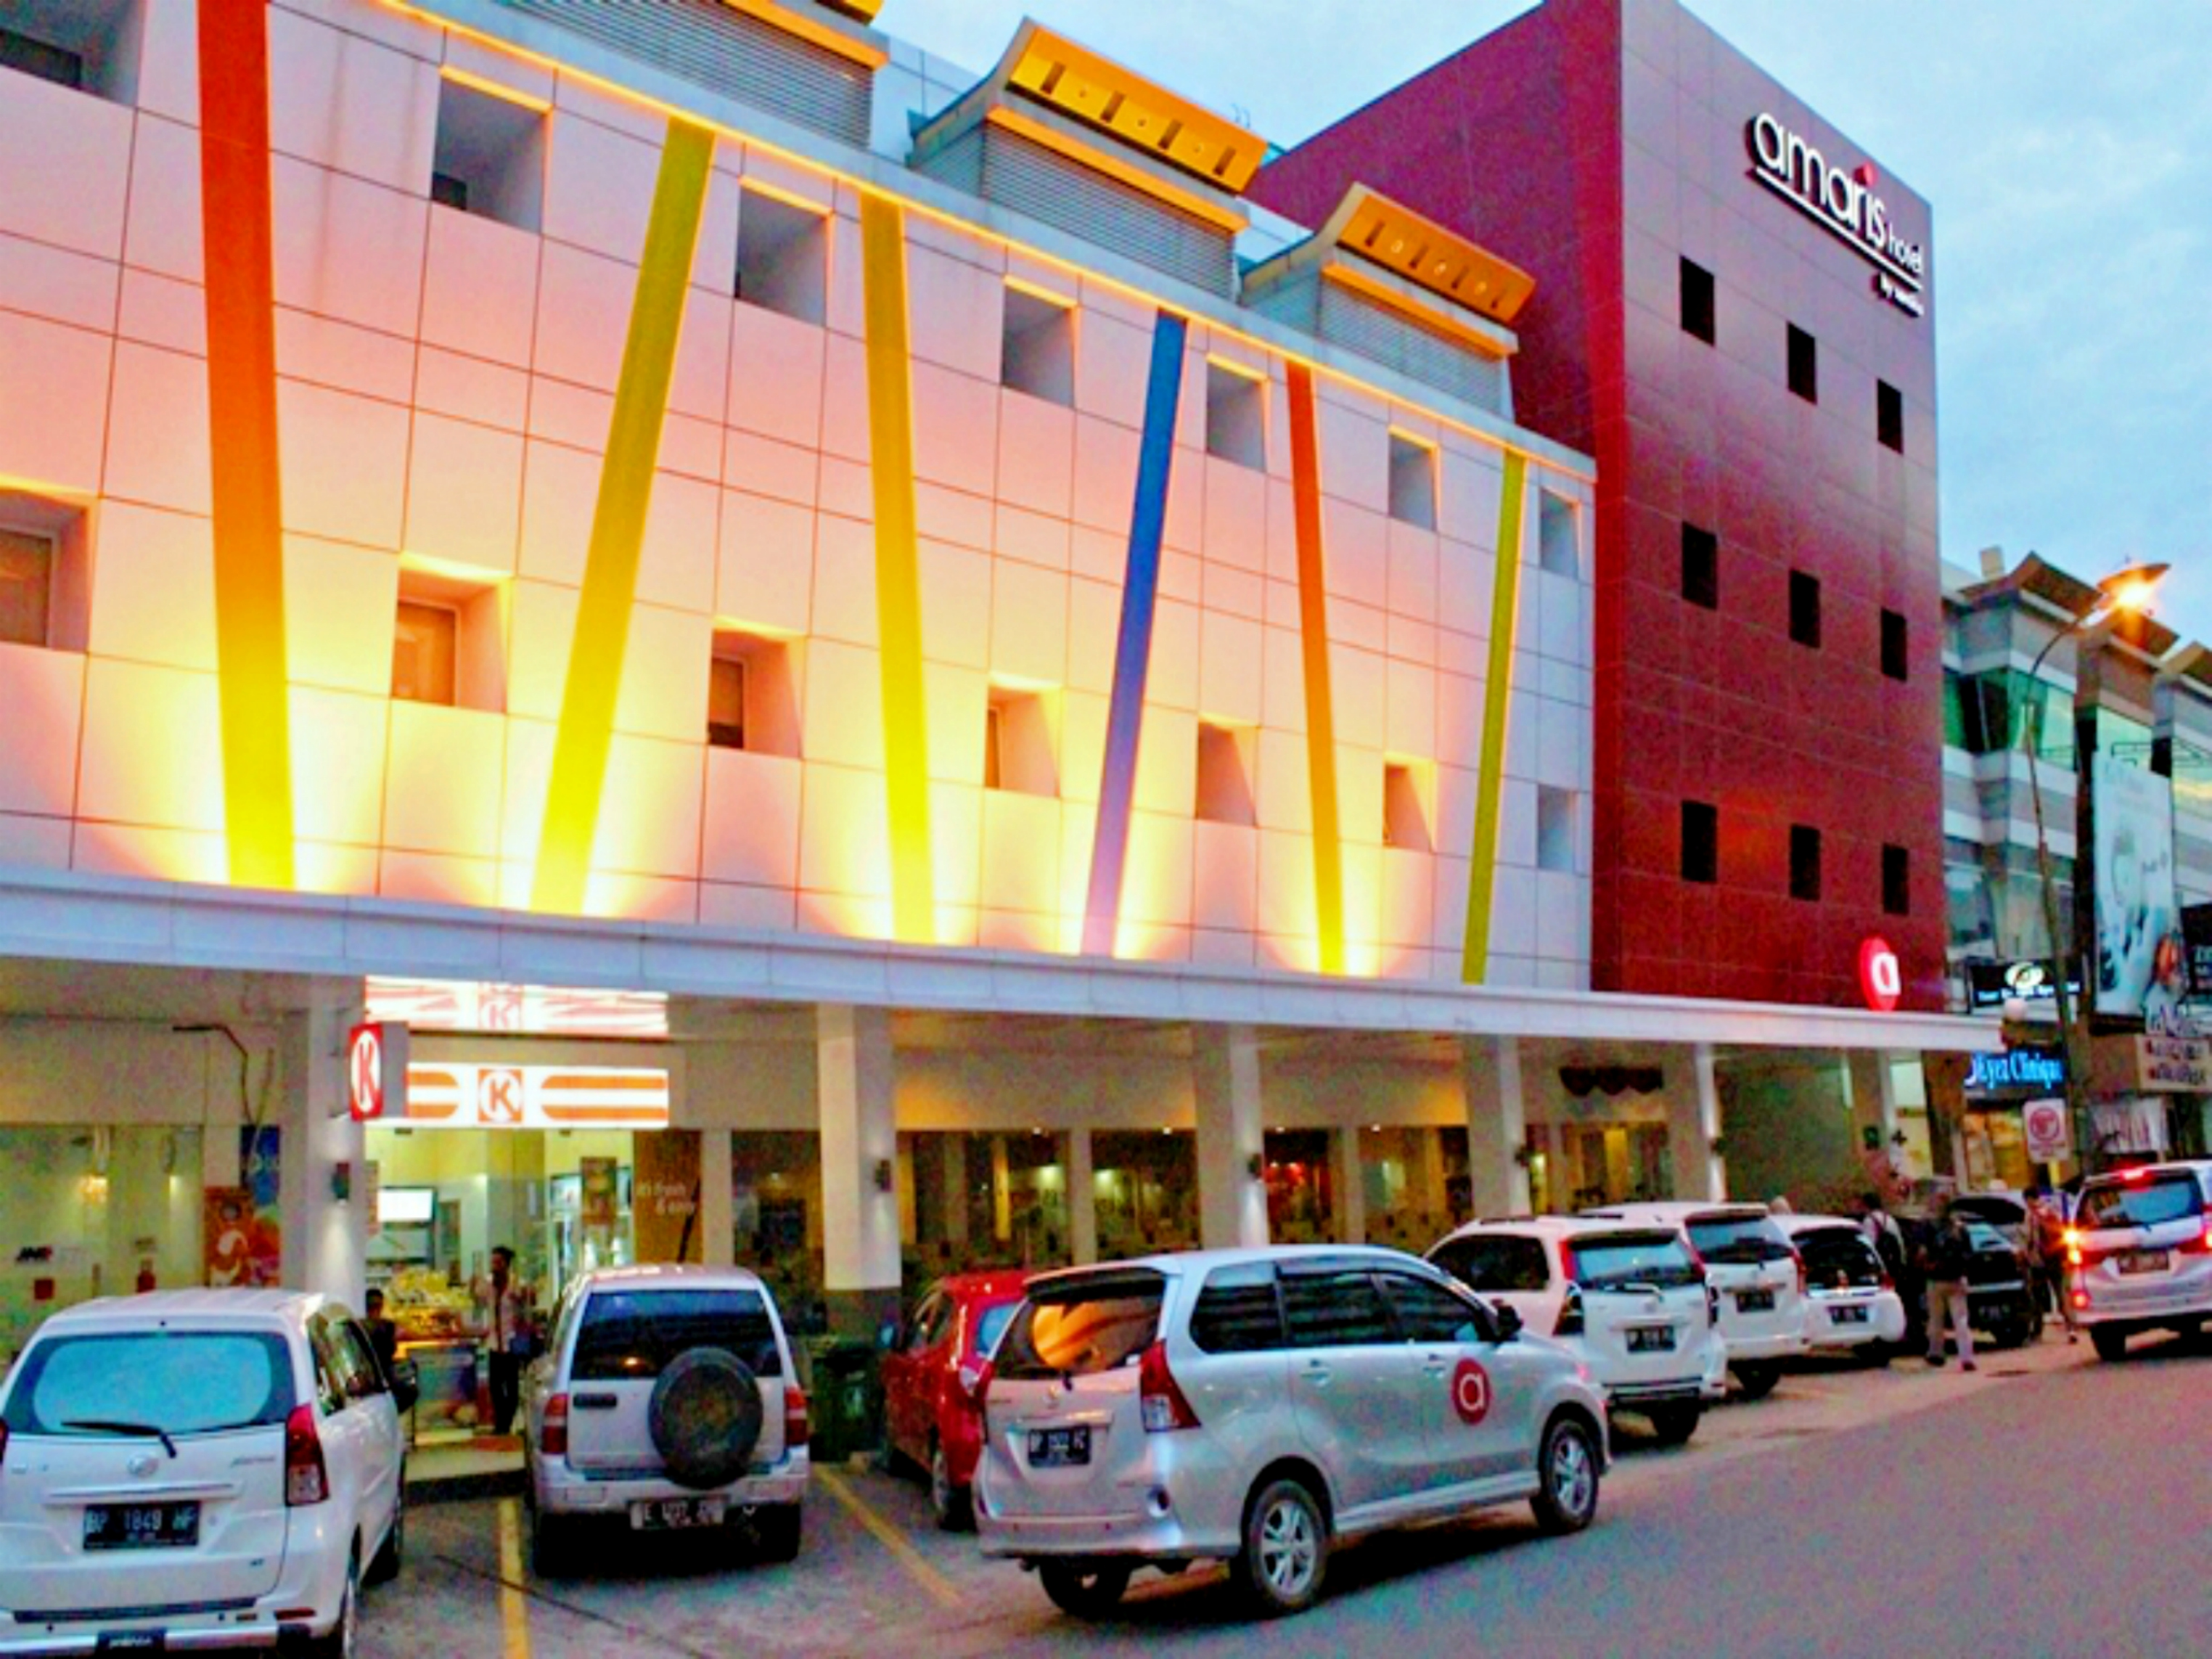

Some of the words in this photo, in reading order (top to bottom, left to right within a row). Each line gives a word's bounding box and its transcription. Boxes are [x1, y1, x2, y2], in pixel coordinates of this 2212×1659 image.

[1753, 112, 1885, 248] amaris
[359, 1042, 380, 1104] K
[488, 1079, 517, 1116] K
